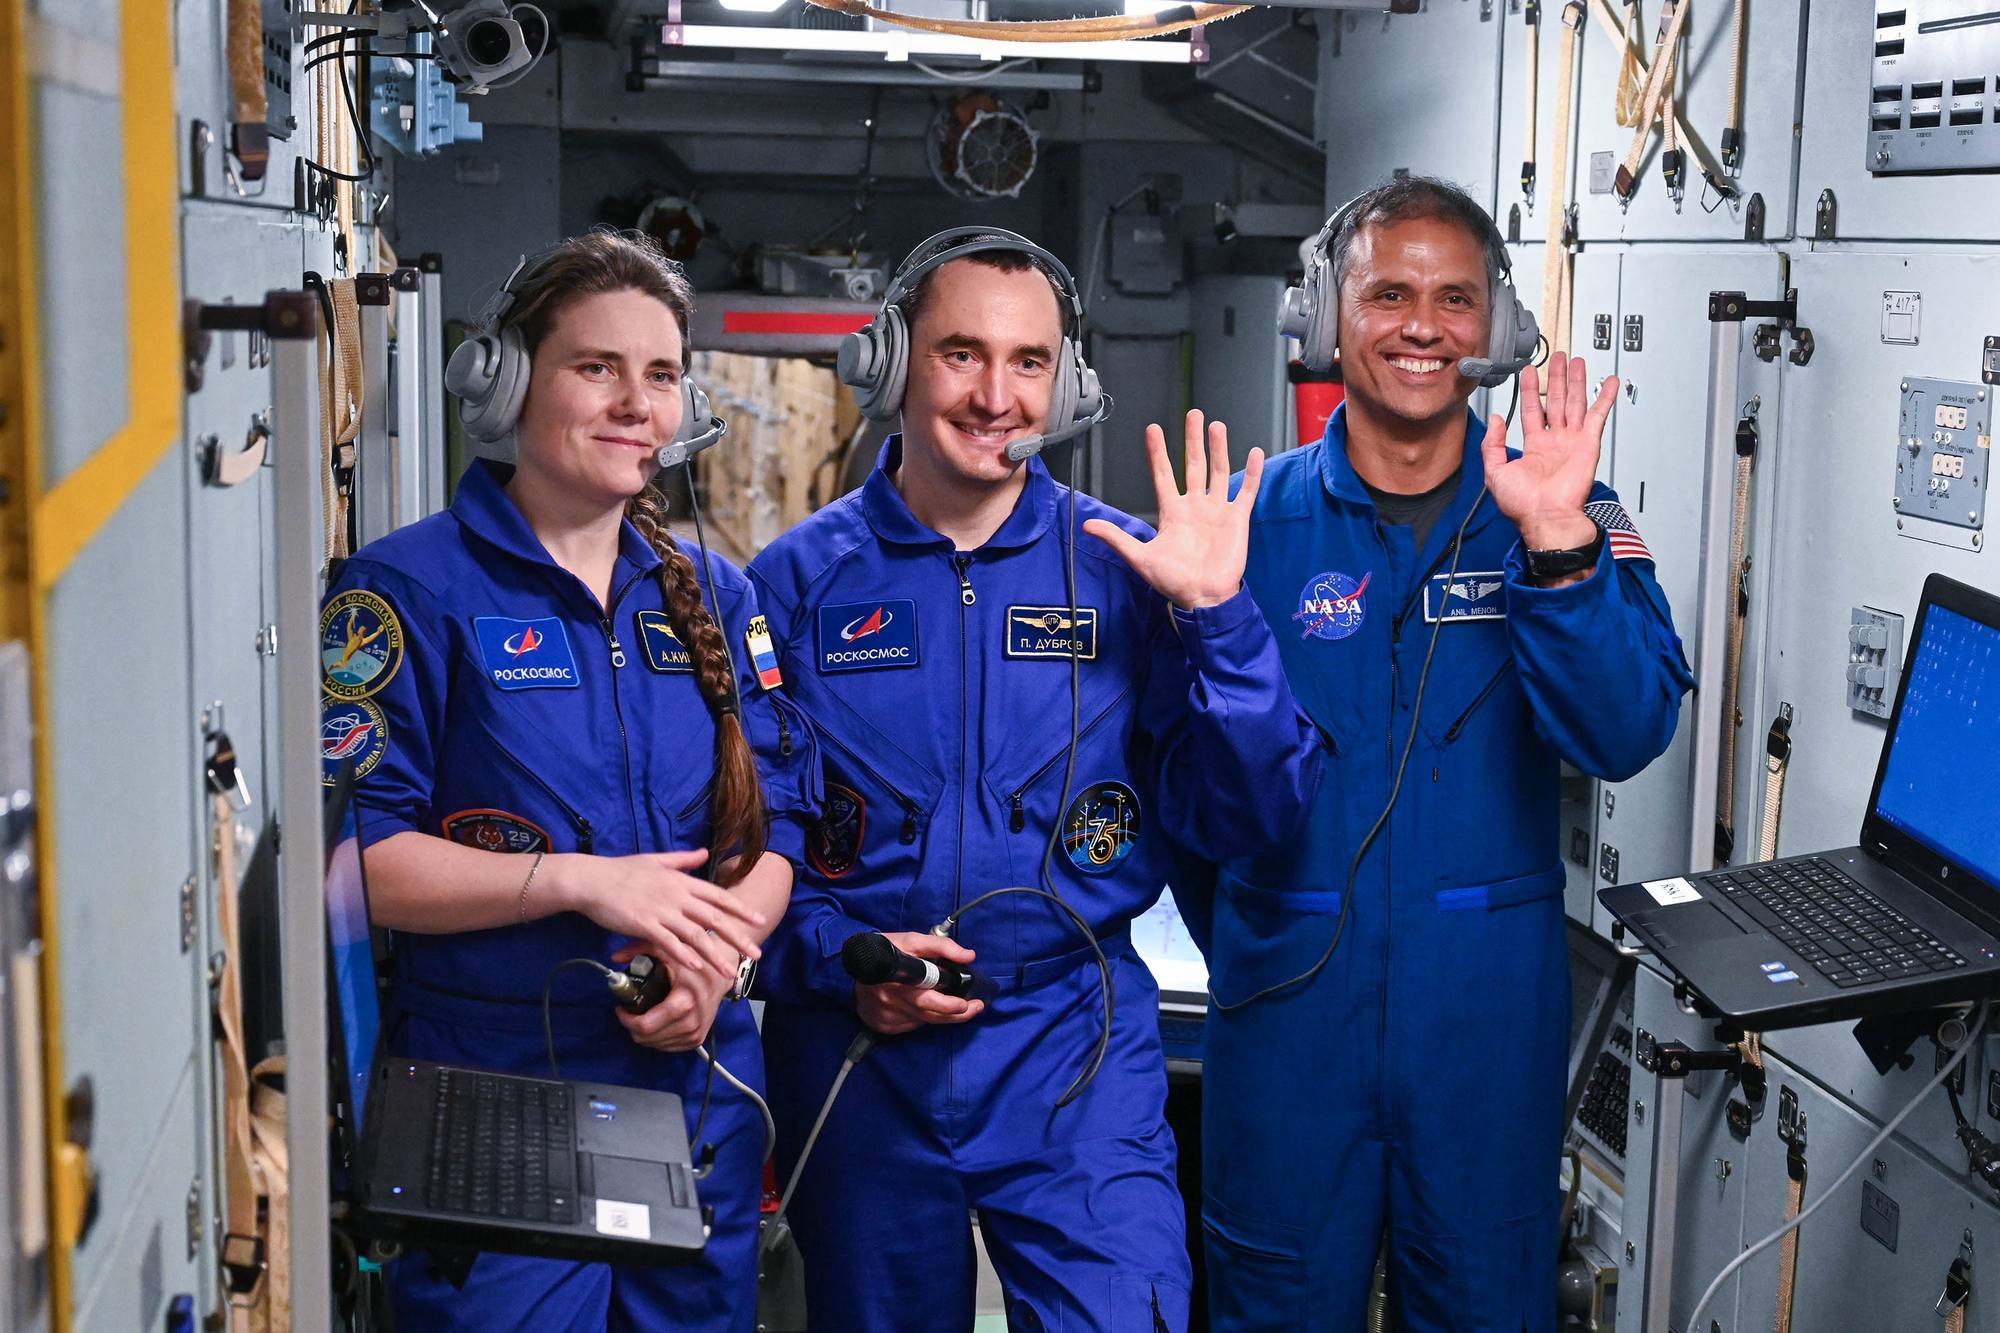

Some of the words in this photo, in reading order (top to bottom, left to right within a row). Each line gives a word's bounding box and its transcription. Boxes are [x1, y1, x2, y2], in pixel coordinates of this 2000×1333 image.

[1896, 297, 1911, 311] 417
[1304, 599, 1362, 614] NASA
[1450, 608, 1468, 616] ANIL
[1471, 606, 1497, 615] MENON
[345, 594, 399, 648] КОСМОНАВТОВ
[827, 647, 909, 663] РОСКОСМОС
[494, 667, 571, 680] РОСКОСМОС
[325, 677, 367, 695] РОССИЯ
[508, 830, 530, 843] 29
[1088, 818, 1119, 864] 75
